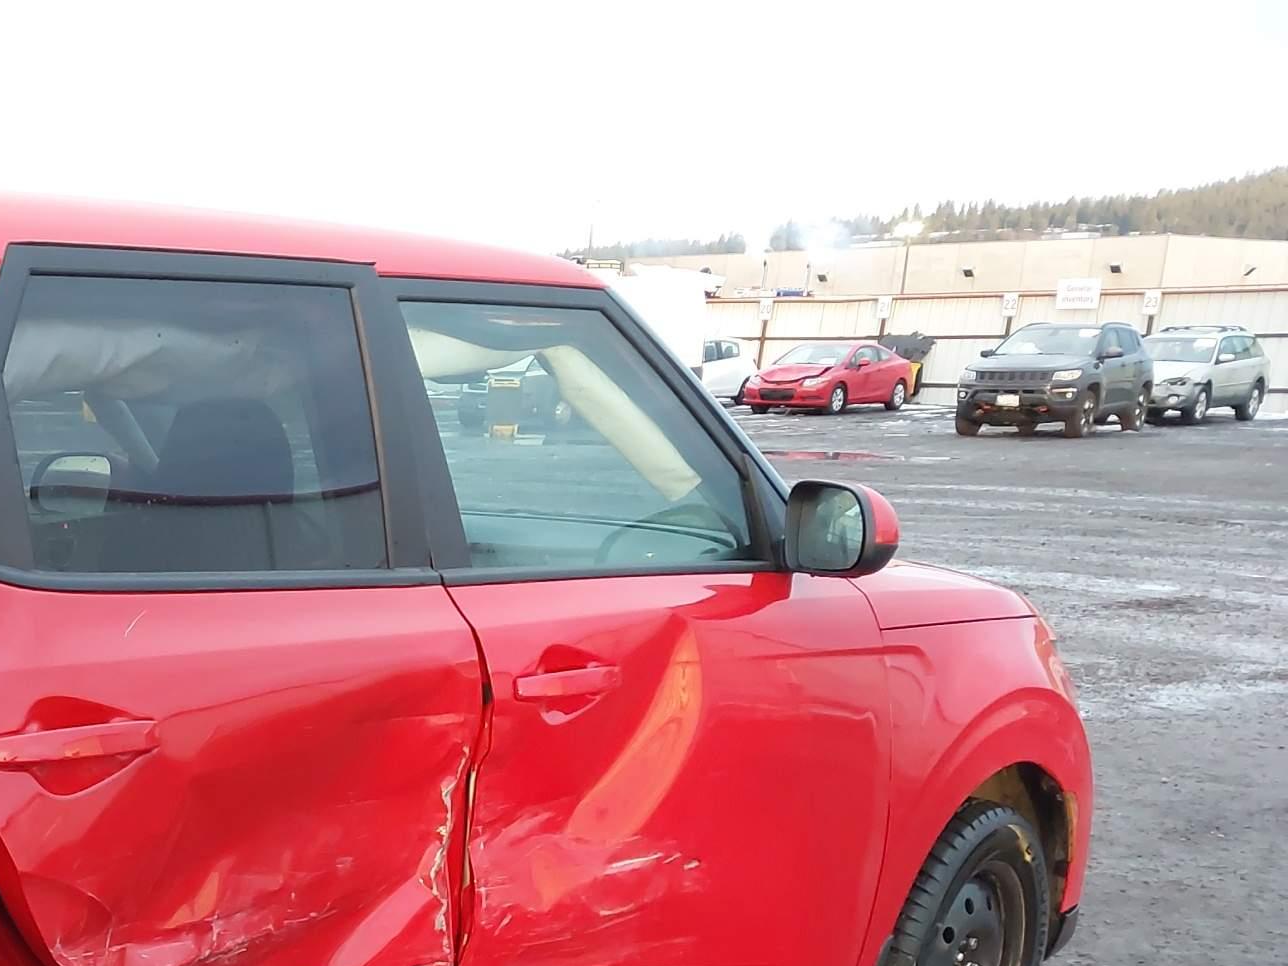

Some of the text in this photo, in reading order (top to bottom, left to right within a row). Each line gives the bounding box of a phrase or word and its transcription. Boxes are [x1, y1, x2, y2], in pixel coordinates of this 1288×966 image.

[1003, 298, 1017, 310] 22
[1144, 296, 1159, 308] 23
[760, 304, 772, 314] 20
